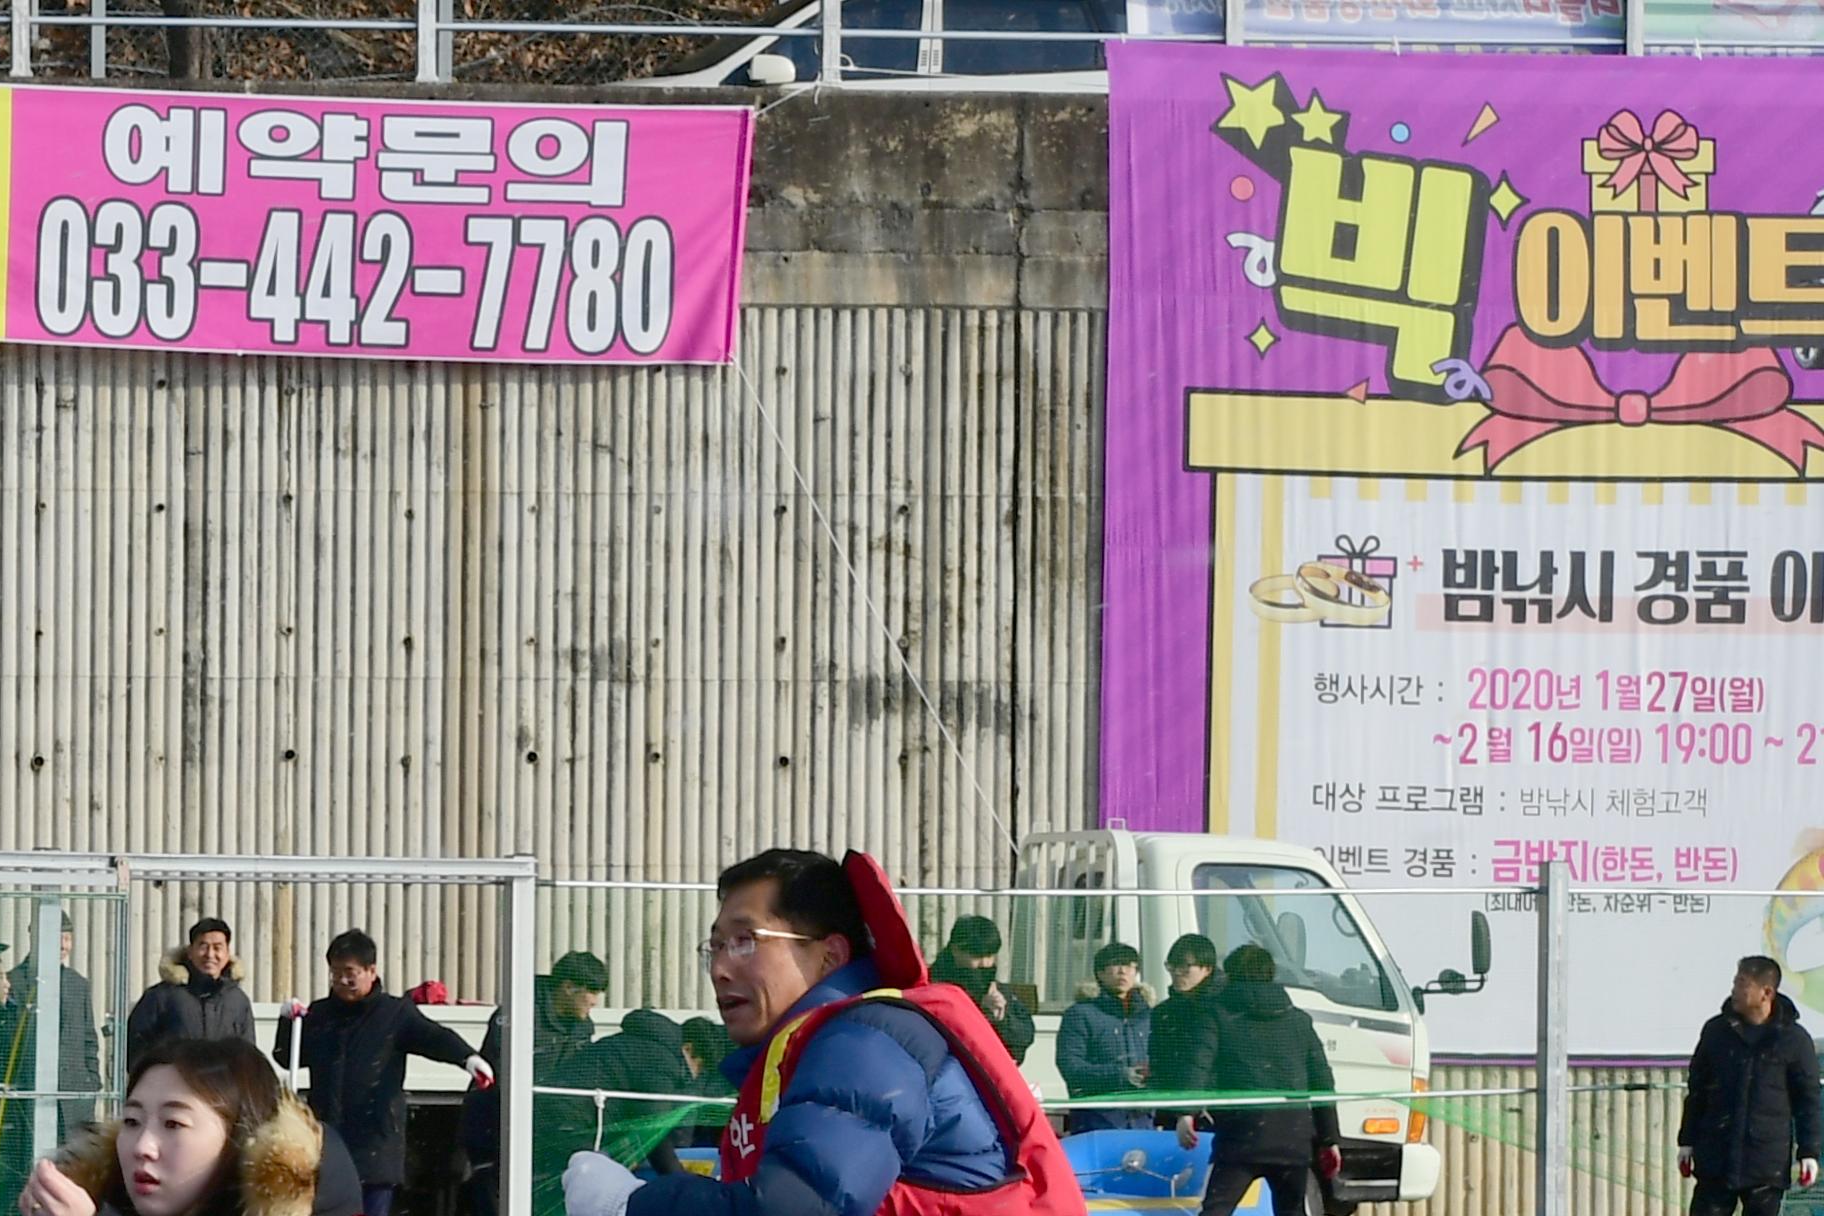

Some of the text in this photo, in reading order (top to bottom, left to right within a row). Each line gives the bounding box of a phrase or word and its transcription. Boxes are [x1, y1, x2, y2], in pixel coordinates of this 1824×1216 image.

[102, 104, 631, 207] 예약문의
[34, 197, 676, 356] 033-442-7780
[1280, 146, 1474, 386] 빅
[1441, 549, 1614, 624] 밤낚시
[1633, 549, 1751, 625] 경품
[1314, 672, 1424, 706] 행사시간
[1467, 667, 1582, 711] 2020년
[1528, 721, 1643, 765] 16일(일)
[1654, 722, 1753, 765] 19:00
[1313, 782, 1366, 813] 대상
[1375, 785, 1485, 816] 프로그램
[1520, 786, 1596, 818] 밤낚시
[1605, 787, 1709, 818] 체험고객
[1404, 847, 1457, 878] 경품
[1674, 845, 1739, 883] 반돈)
